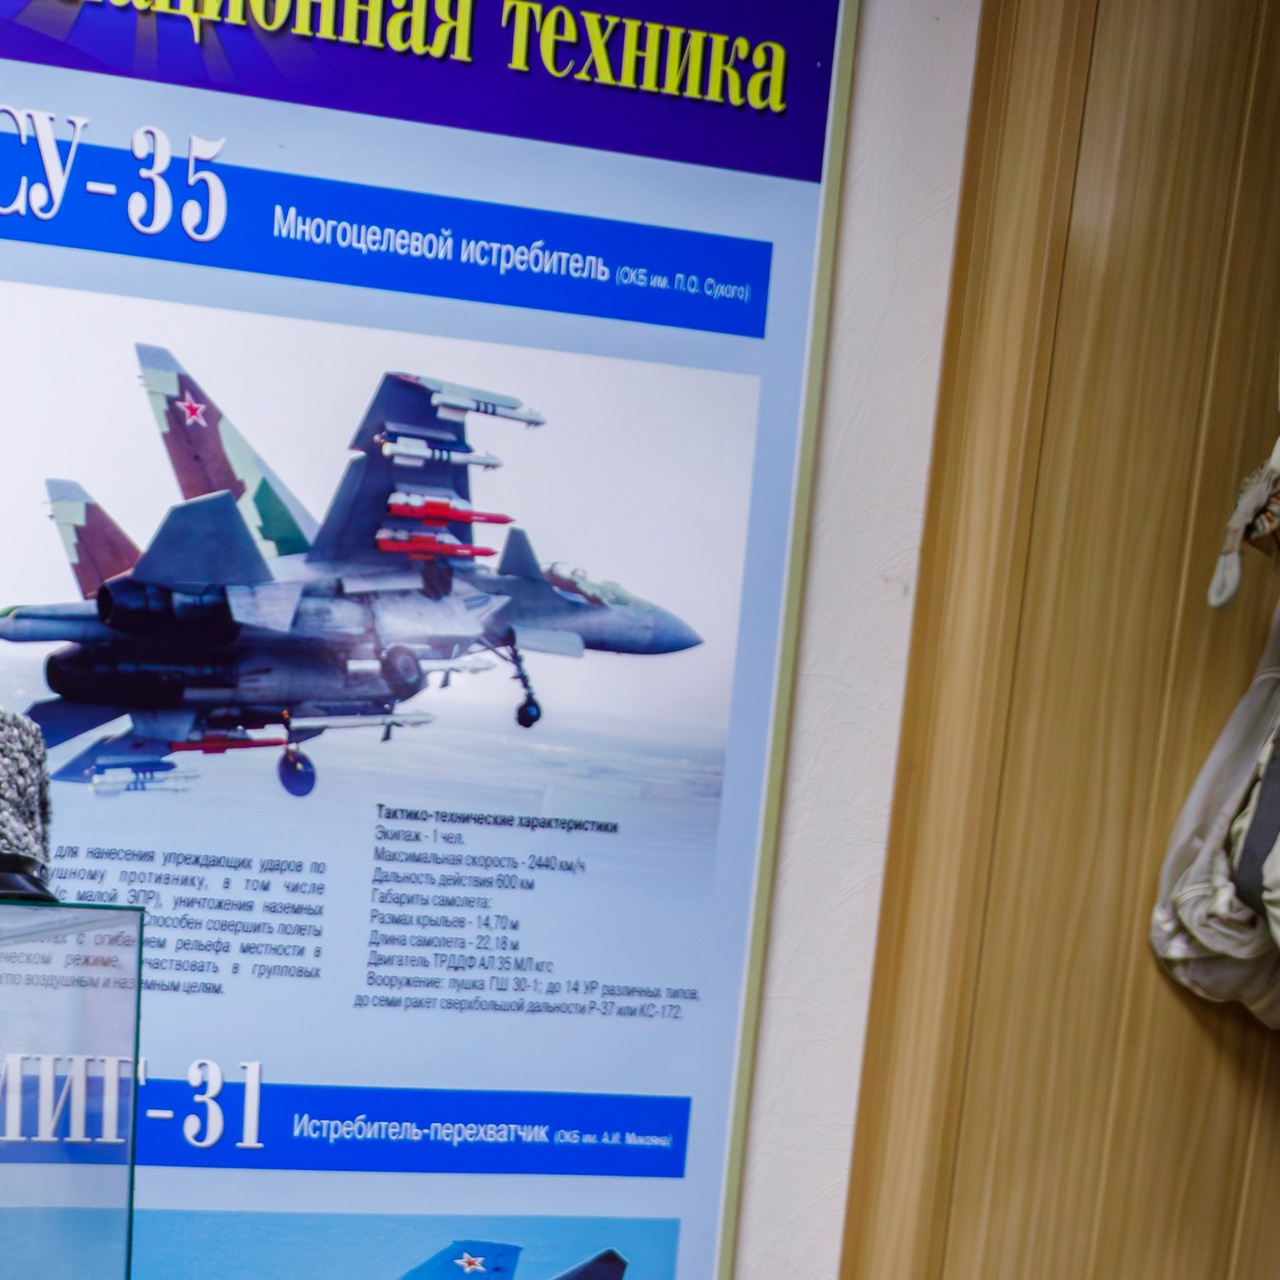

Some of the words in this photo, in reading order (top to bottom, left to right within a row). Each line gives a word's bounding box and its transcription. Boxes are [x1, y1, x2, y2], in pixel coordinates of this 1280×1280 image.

[503, 2, 786, 114] техника
[273, 204, 453, 260] Многоцелевой
[461, 238, 610, 284] истребитель
[376, 803, 514, 828] Тактико-технические
[517, 813, 619, 834] характеристики
[375, 825, 422, 842] Экипаж
[54, 844, 79, 859] для
[86, 848, 155, 863] нанесения
[162, 850, 252, 871] упреждающих
[259, 857, 303, 874] ударов
[373, 846, 463, 867] Максимальная
[465, 854, 519, 870] скорость
[528, 855, 558, 871] 2440
[120, 868, 209, 890] противнику,
[244, 878, 270, 891] том
[283, 881, 325, 895] числе
[372, 866, 436, 885] Дальность
[438, 871, 494, 888] действия
[496, 874, 518, 889] 600
[76, 887, 118, 903] малой
[171, 895, 255, 912] уничтожения
[262, 899, 325, 916] наземных
[370, 889, 430, 908] Габариты
[432, 894, 492, 909] самолета:
[205, 918, 274, 936] совершить
[277, 922, 323, 937] полеты
[370, 909, 413, 926] Размах
[415, 914, 466, 930] крыльев
[476, 914, 509, 931] 14,70
[174, 936, 230, 954] рельефа
[238, 942, 305, 957] местности
[368, 930, 407, 948] Длина
[409, 934, 466, 949] самолета
[251, 962, 321, 981] групповых
[367, 950, 431, 968] Двигатель
[433, 953, 477, 972] ТРДДФ
[182, 980, 225, 996] целям.
[366, 970, 445, 989] Вооружение:
[448, 976, 485, 993] пушка
[601, 983, 662, 999] различных
[403, 996, 438, 1011] ракет
[440, 995, 526, 1013] сверхбольшой
[526, 1000, 586, 1015] дальности
[588, 1001, 615, 1015] Р-37
[292, 1113, 549, 1146] Истребитель-перехватчик
